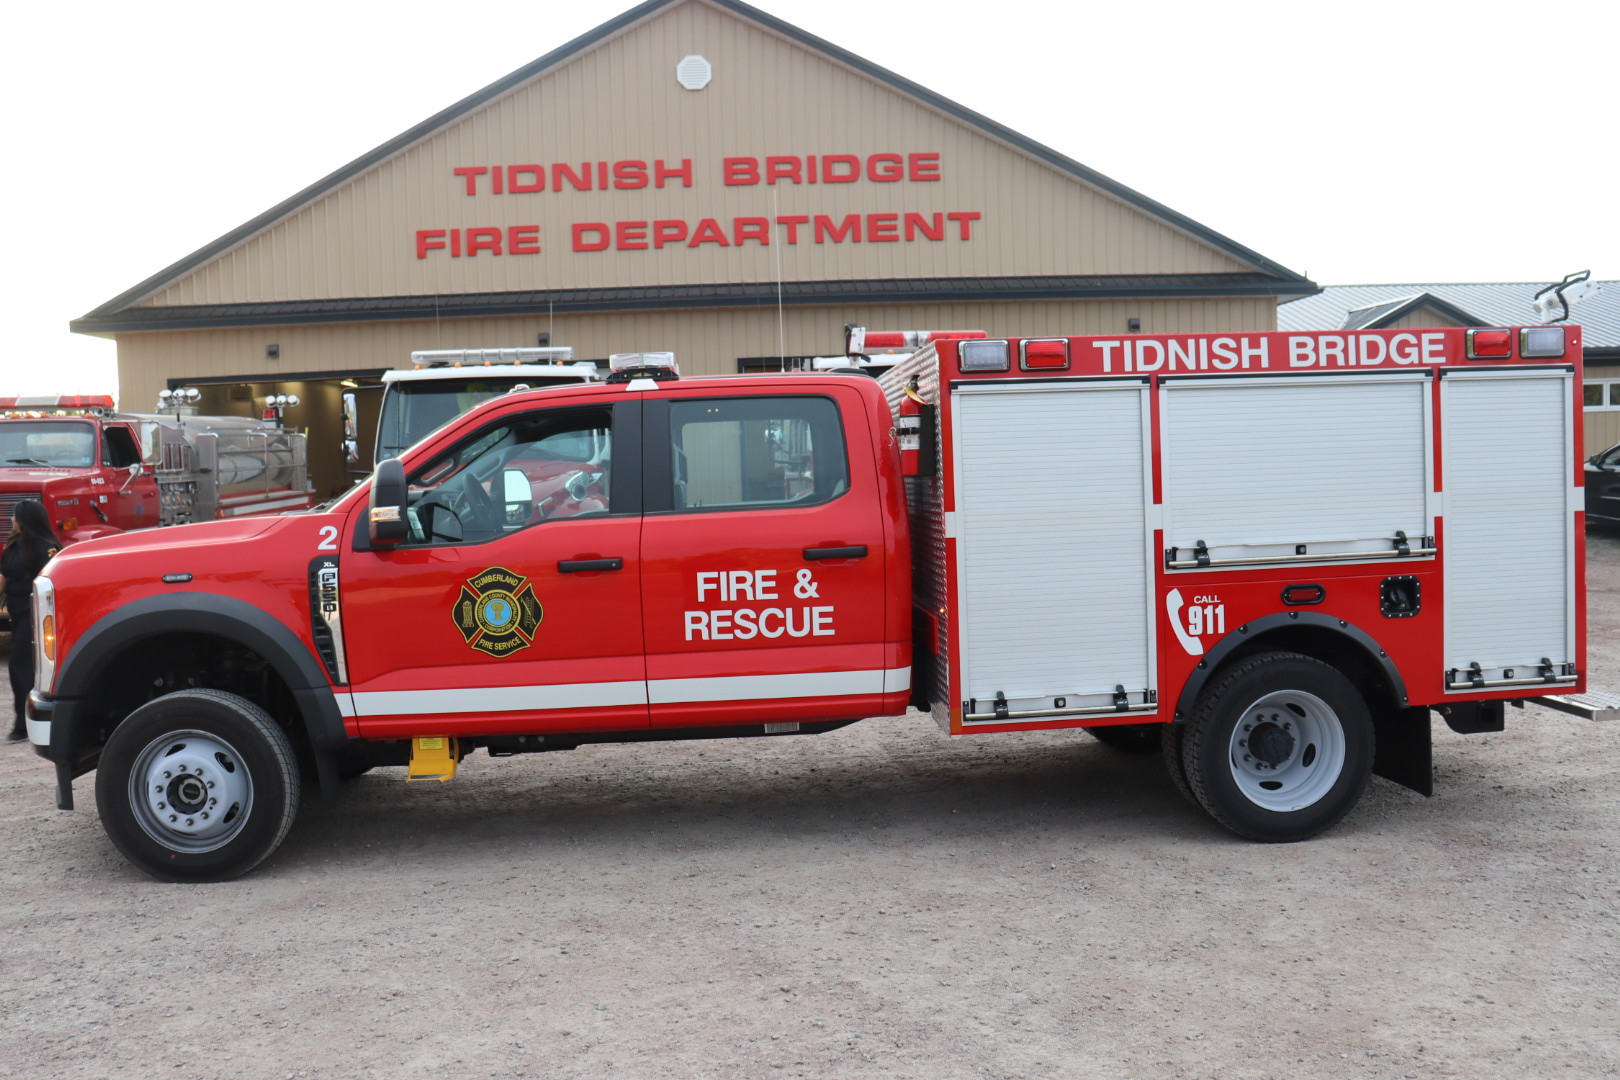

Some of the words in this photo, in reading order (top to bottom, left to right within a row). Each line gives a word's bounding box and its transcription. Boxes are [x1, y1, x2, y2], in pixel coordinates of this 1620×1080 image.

[454, 158, 693, 196] TIDNISH
[722, 152, 942, 187] BRIDGE
[416, 225, 541, 259] FIRE
[571, 211, 982, 253] DEPARTMENT
[1092, 336, 1270, 373] TIDNISH
[1288, 332, 1447, 368] BRIDGE
[317, 525, 338, 550] 2
[474, 573, 519, 588] CUMBERLAND
[696, 569, 779, 603] FIRE
[793, 568, 820, 599] &
[1193, 594, 1221, 604] CALL
[684, 605, 836, 641] RESCUE
[1188, 604, 1225, 635] 911
[478, 638, 493, 650] FIRE
[494, 636, 522, 651] SERVICE
